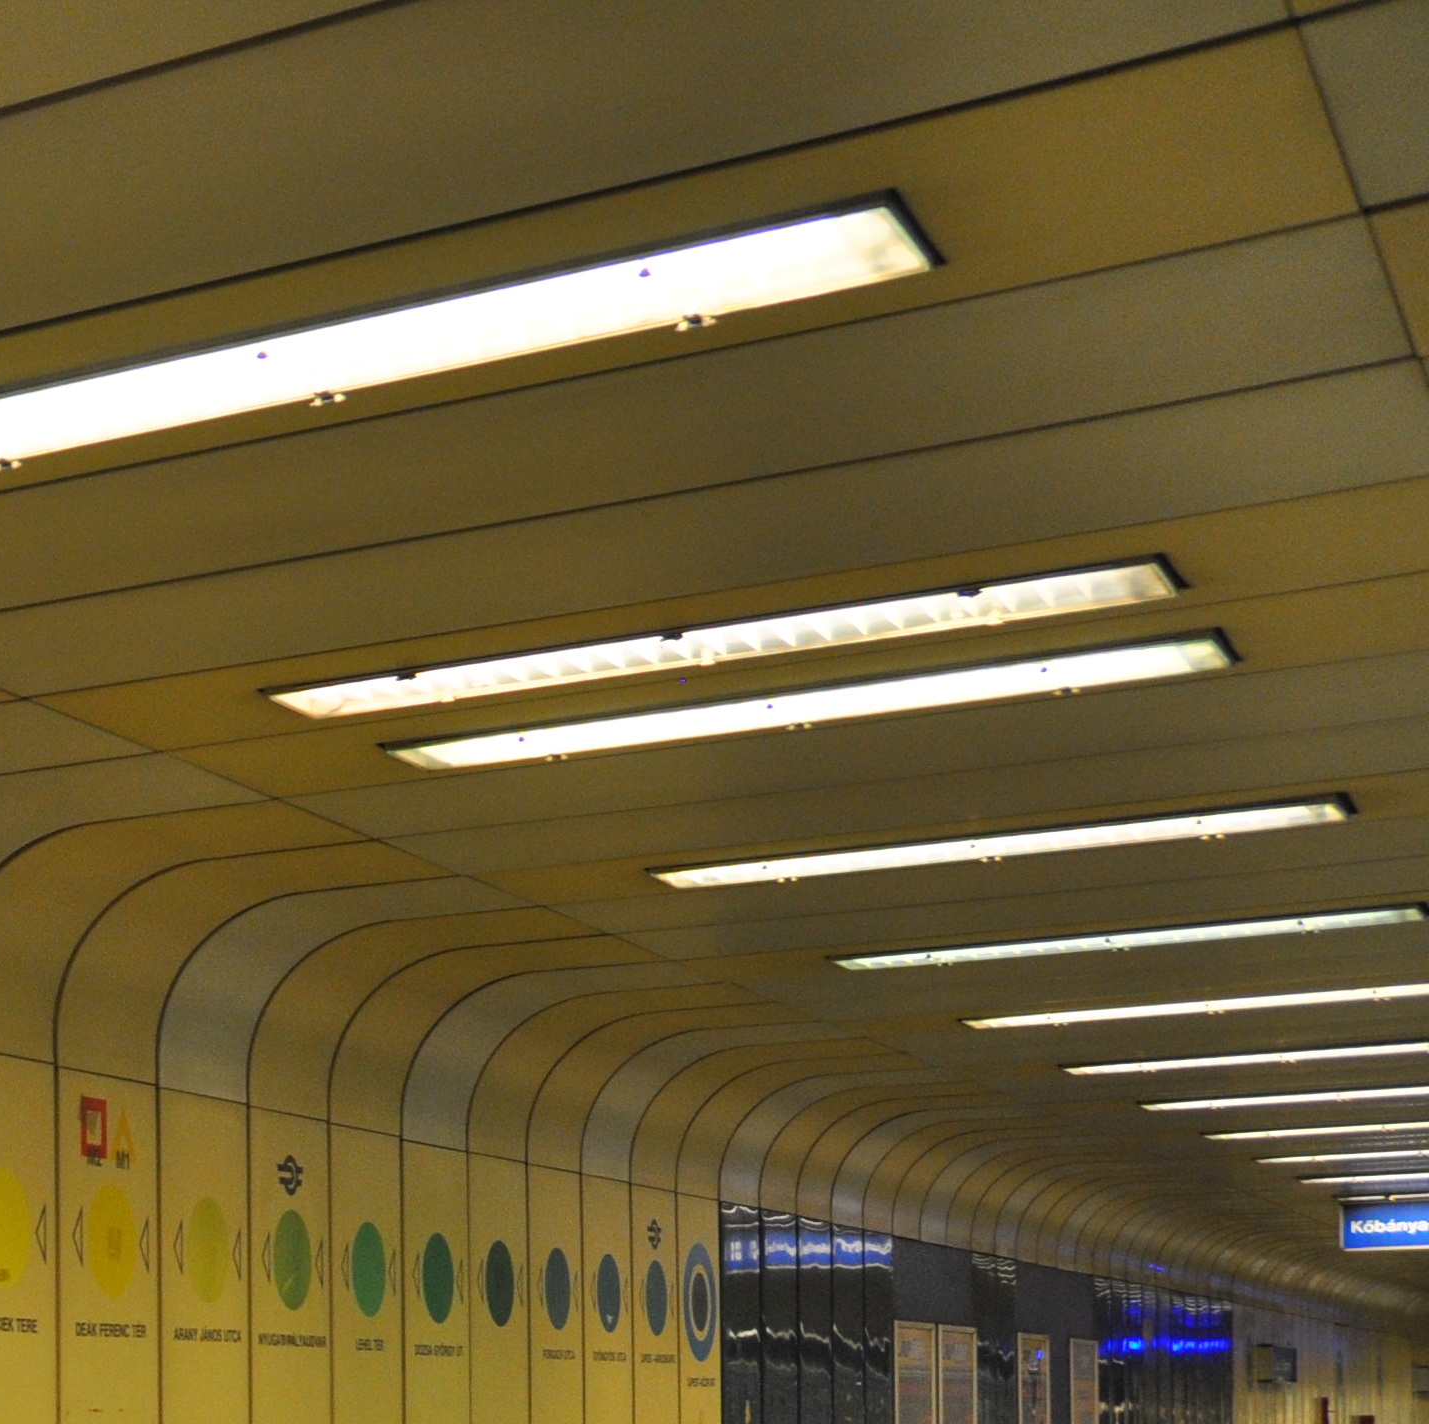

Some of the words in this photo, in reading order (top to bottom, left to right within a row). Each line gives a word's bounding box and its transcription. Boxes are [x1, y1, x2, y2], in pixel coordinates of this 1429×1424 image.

[116, 1150, 130, 1169] M1
[16, 1318, 38, 1334] TERE
[76, 1320, 98, 1337] DEÁK
[99, 1322, 130, 1338] FERENC
